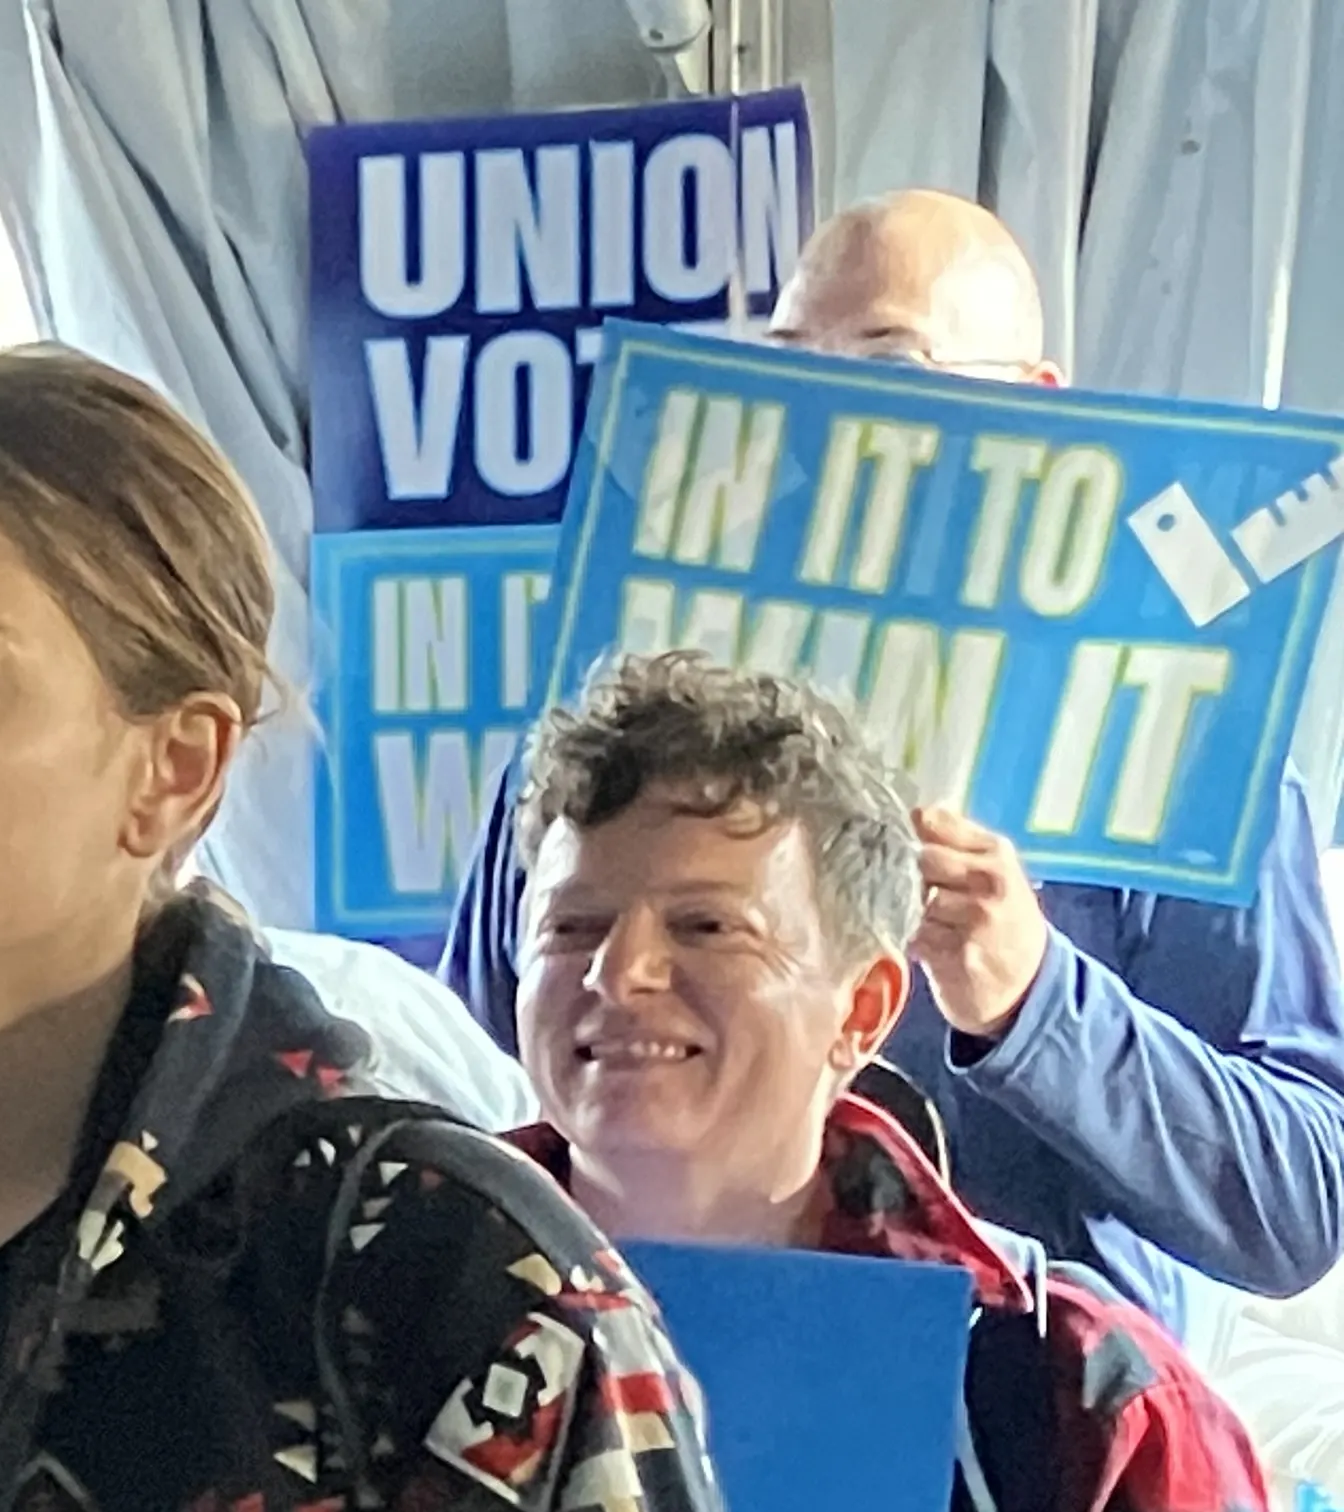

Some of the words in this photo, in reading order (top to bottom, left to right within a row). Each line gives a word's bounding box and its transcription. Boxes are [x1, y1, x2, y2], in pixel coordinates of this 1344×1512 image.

[358, 120, 799, 318] UNION
[363, 329, 603, 500] VO
[633, 388, 786, 573] IN
[799, 414, 940, 596] IT
[962, 432, 1123, 618] TO
[373, 573, 468, 712] IN
[1026, 638, 1232, 846] IT
